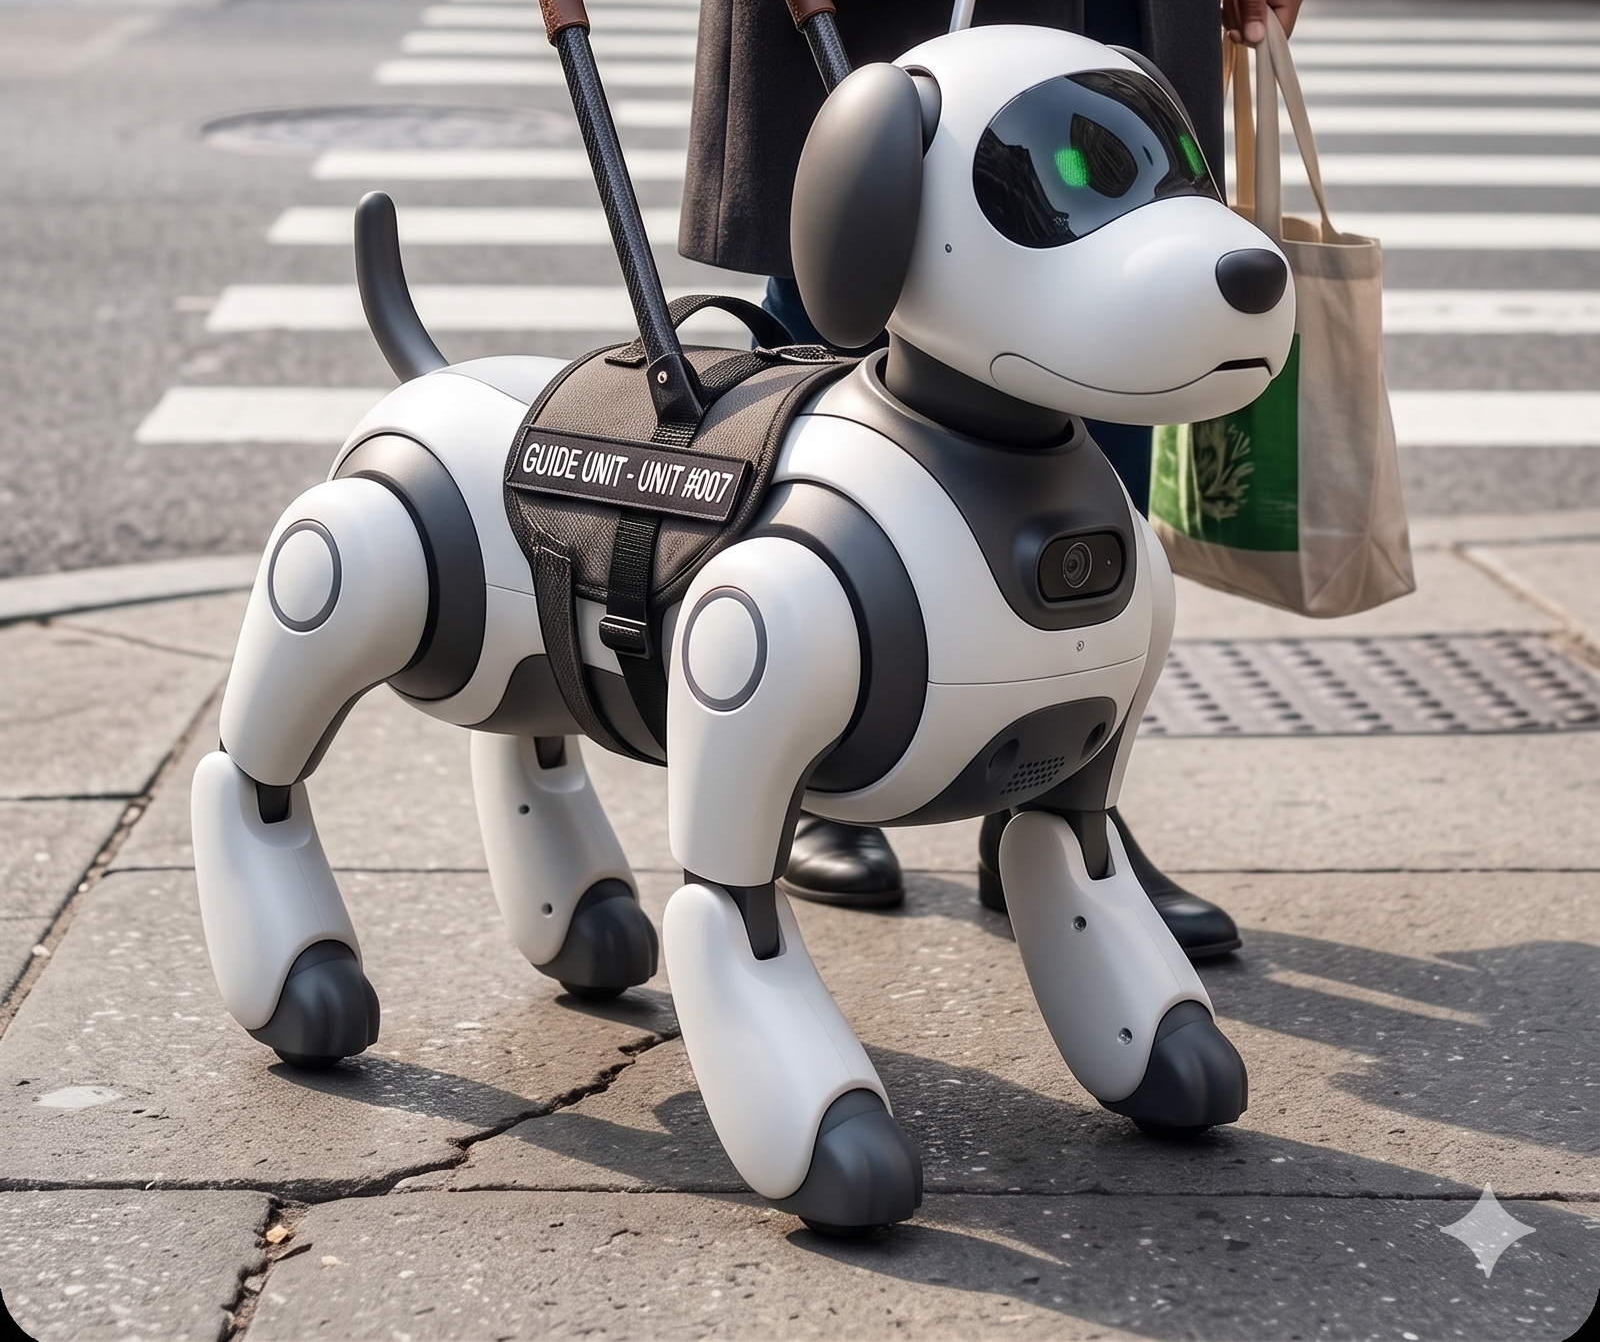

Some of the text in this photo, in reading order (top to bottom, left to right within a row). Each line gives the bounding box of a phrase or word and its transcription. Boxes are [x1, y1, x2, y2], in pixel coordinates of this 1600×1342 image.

[522, 443, 583, 479] GUIDE
[581, 451, 629, 487] UNIT
[638, 459, 686, 495] UNIT
[680, 467, 734, 503] #007
